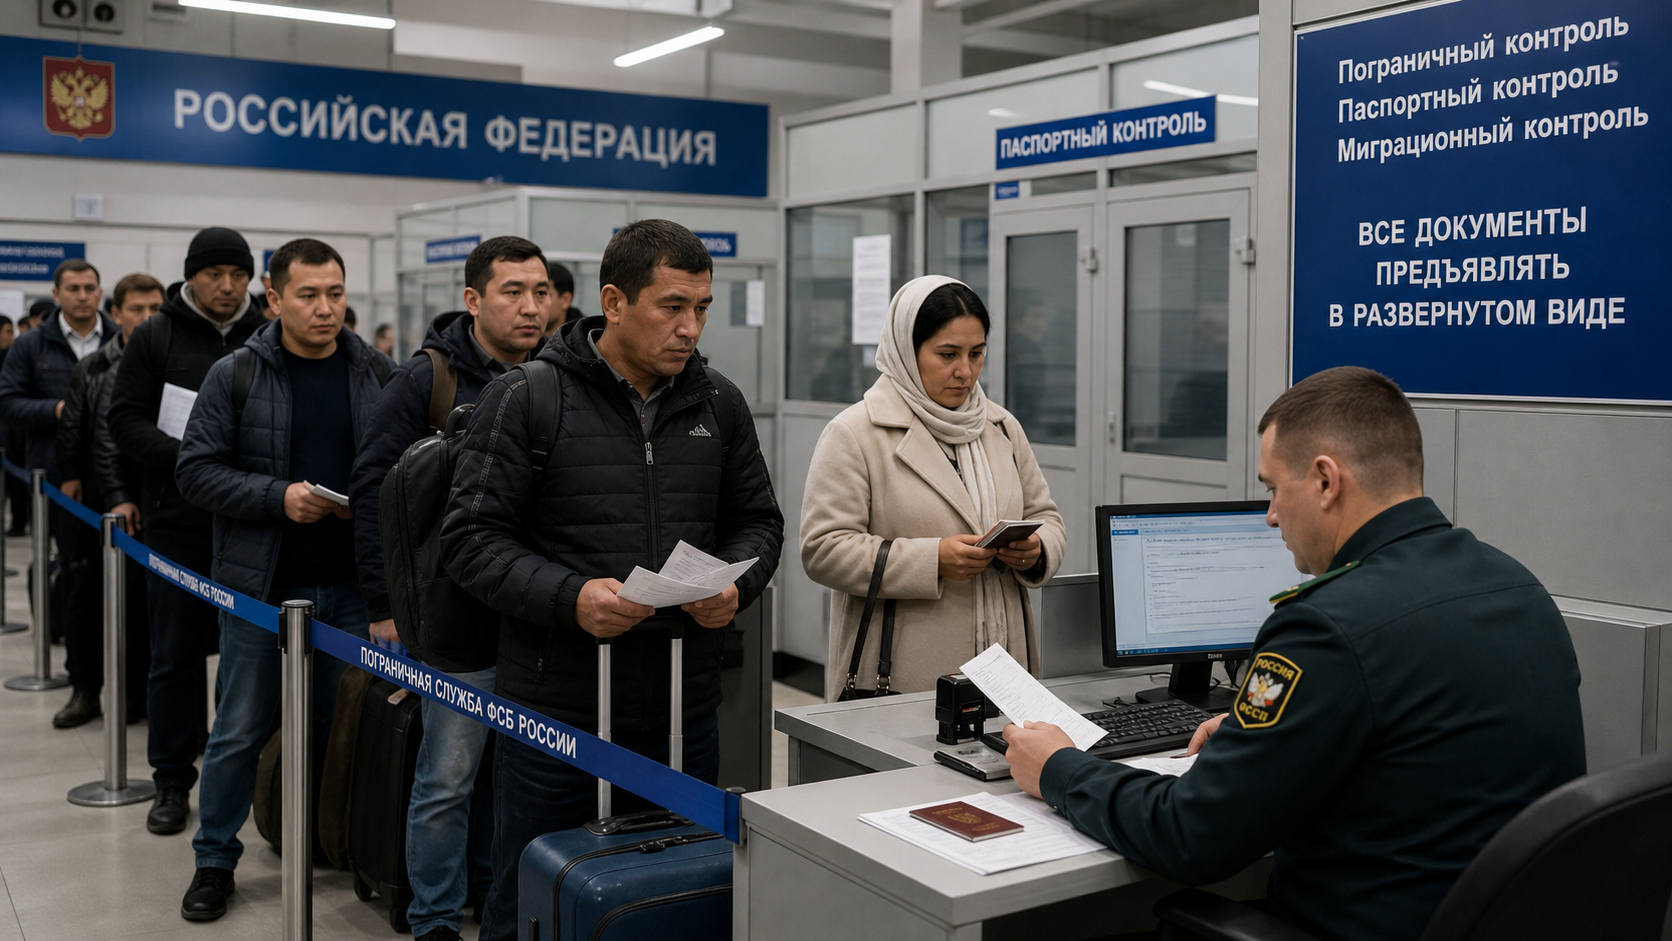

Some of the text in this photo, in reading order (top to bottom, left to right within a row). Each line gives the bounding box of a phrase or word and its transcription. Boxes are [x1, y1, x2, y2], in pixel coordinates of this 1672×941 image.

[1338, 15, 1629, 84] Пограничный контроль
[1338, 63, 1619, 124] Паспортный контроль
[174, 89, 718, 167] РОССИЙСКАЯ ФЕДЕРАЦИЯ
[1000, 110, 1207, 160] ПАСПОРТНЫЙ КОНТРОЛЬ
[1338, 106, 1649, 164] Миграционный контроль
[1358, 206, 1588, 248] ВСЕ ДОКУМЕНТЫ
[1376, 253, 1570, 289] ПРЕДЪЯВЛЯТЬ
[1329, 297, 1626, 330] В РАЗВЕРНУТОМ ВИДЕ
[361, 646, 577, 759] ПОГРАНИЧНАЯ СЛУЖБА ФСБ РОССИИ
